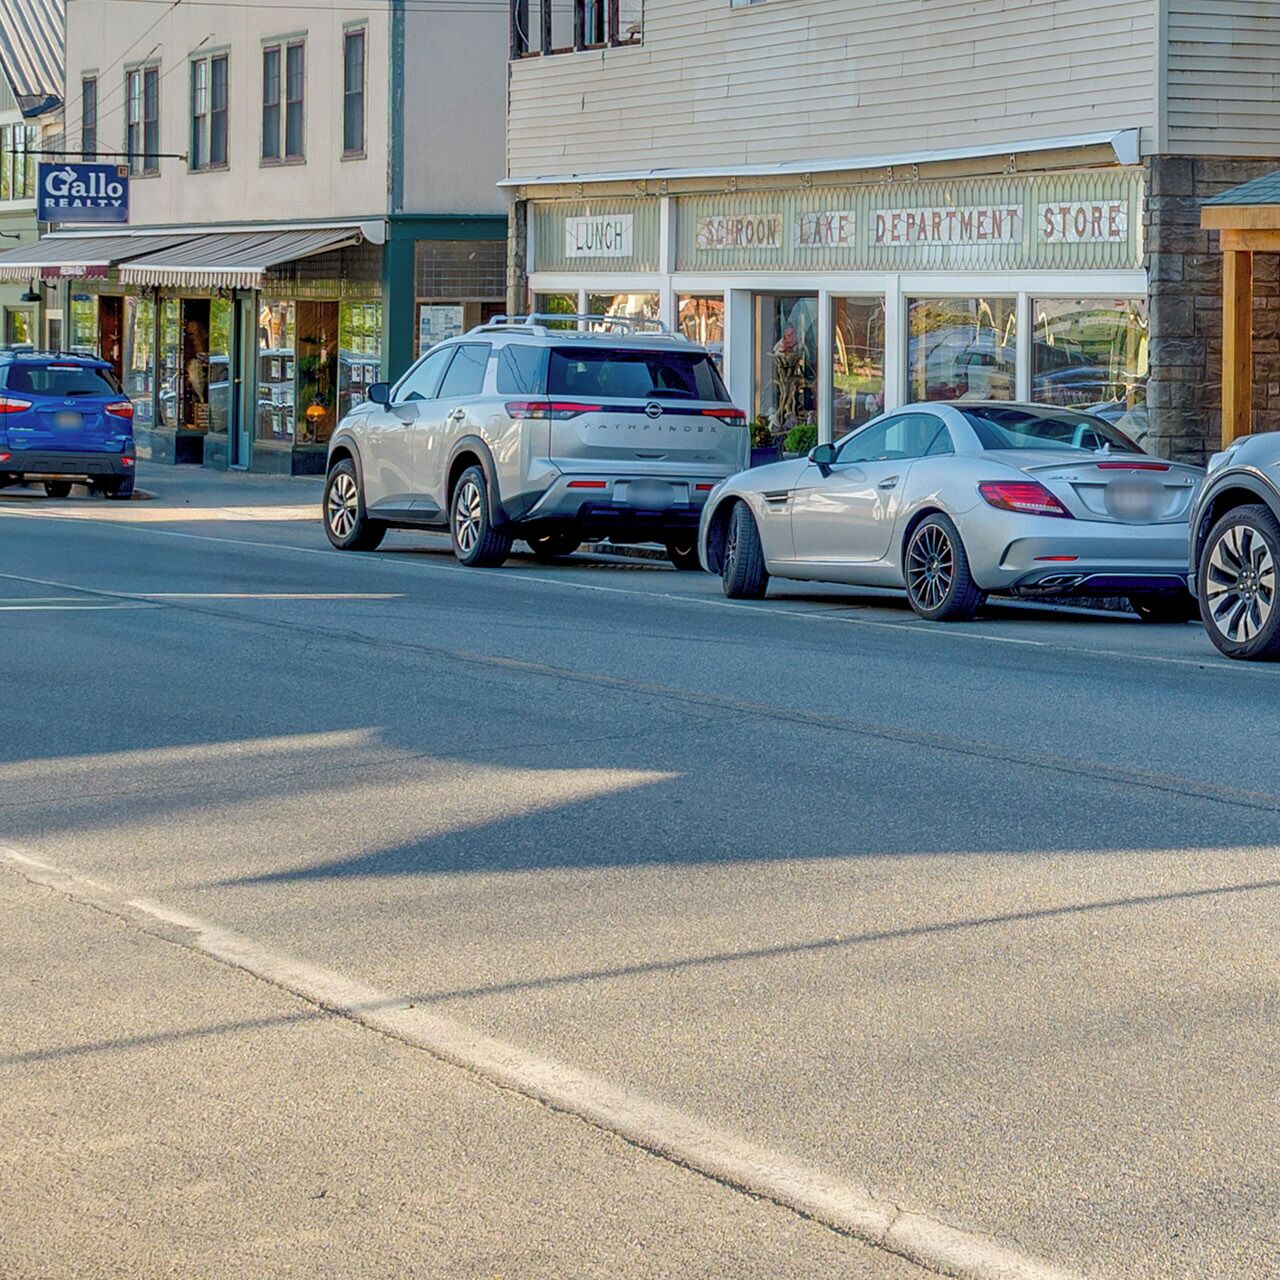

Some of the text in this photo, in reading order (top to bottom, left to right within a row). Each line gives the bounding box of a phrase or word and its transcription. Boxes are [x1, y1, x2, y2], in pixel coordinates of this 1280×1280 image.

[45, 166, 123, 198] Gallo
[45, 198, 122, 208] REALTY
[576, 222, 623, 250] LUNCH
[706, 205, 1121, 246] SCHROON LAKE DEPARTMENT STORE
